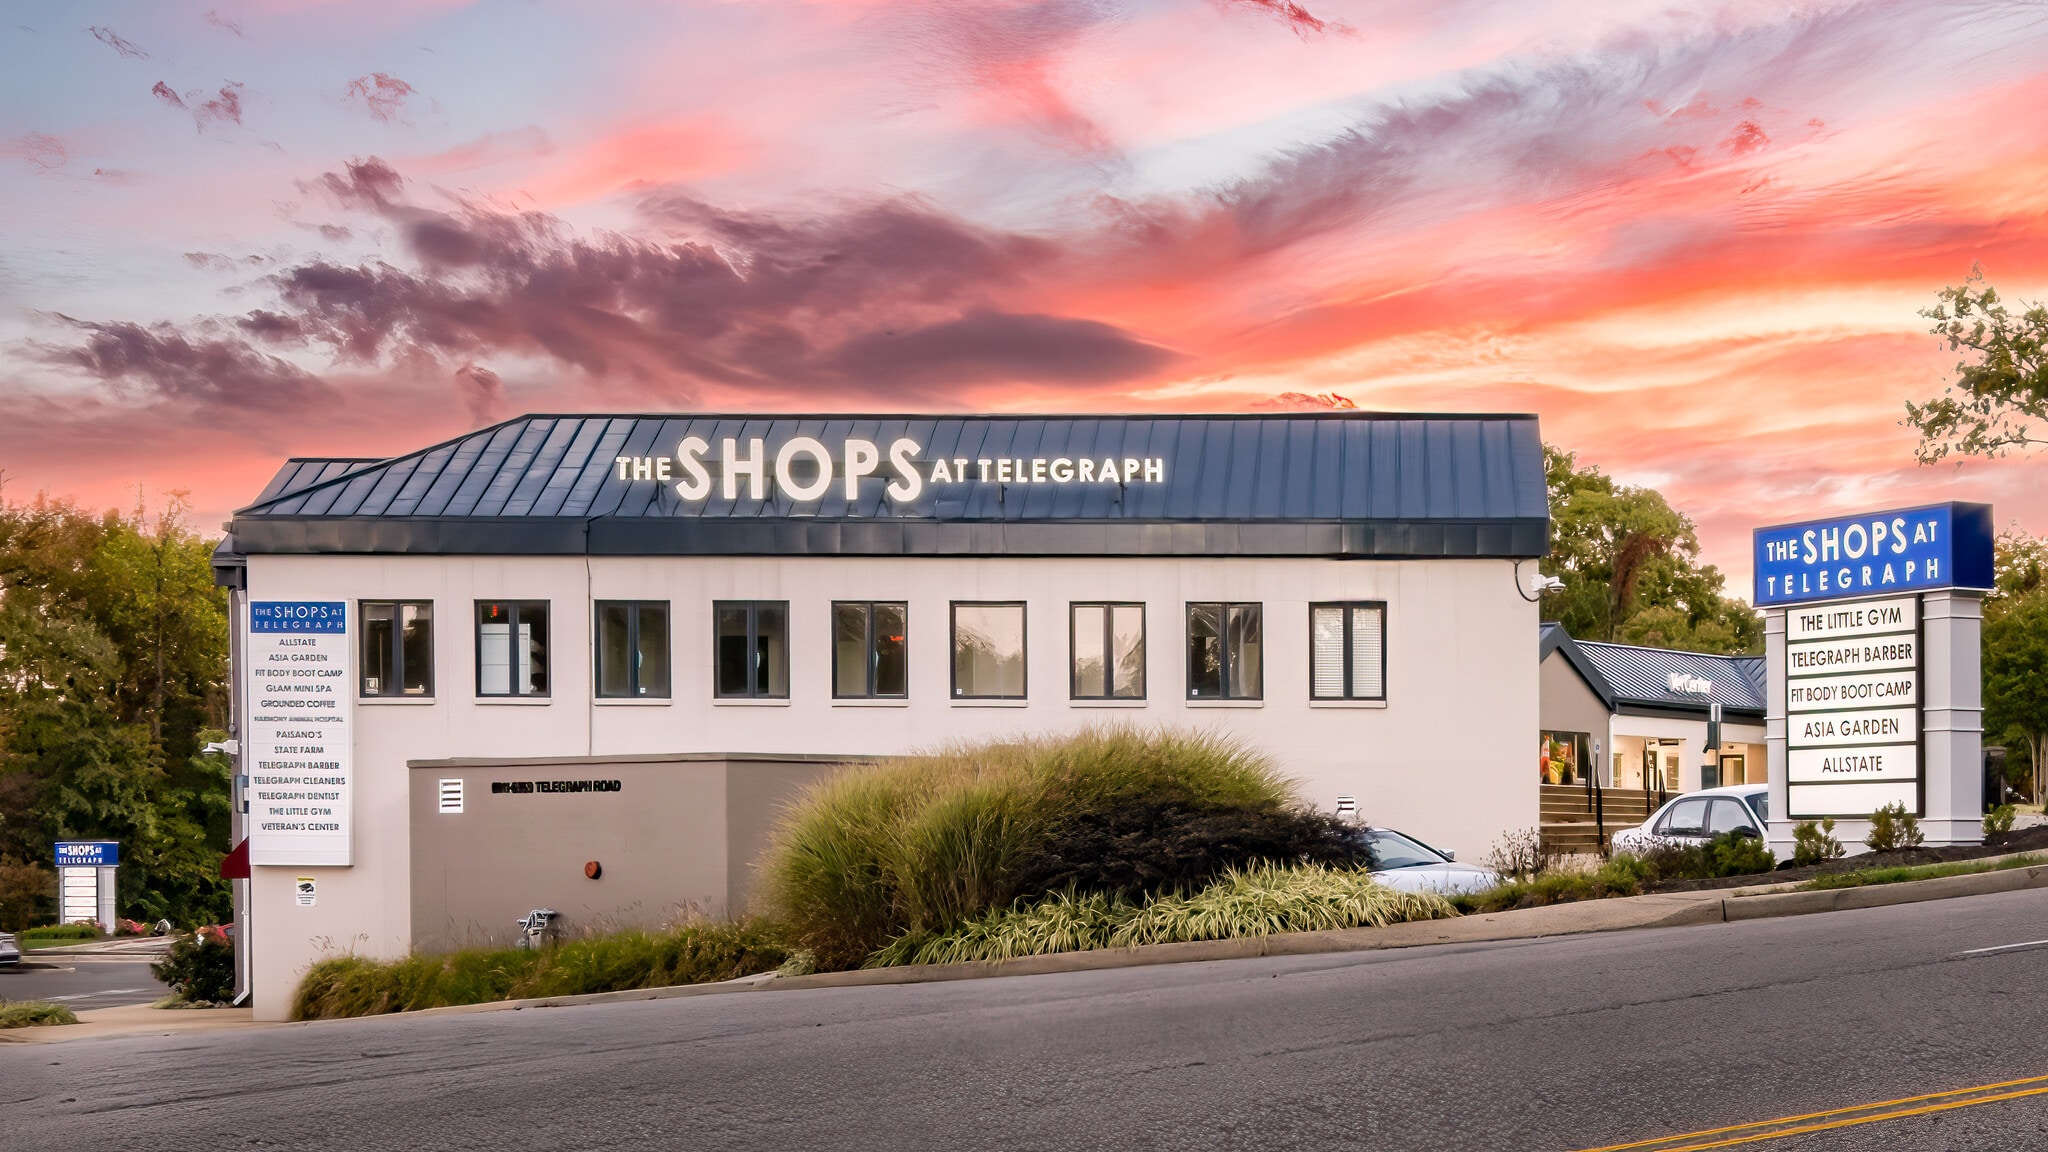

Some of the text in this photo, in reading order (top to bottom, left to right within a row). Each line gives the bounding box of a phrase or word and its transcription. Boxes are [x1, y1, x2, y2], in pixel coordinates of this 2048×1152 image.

[616, 437, 1163, 501] THE SHOPS AT TELEGRAPH
[1766, 518, 1938, 565] THE SHOPS AT
[1767, 558, 1939, 597] TELEGRAPH
[255, 606, 343, 619] THE SHOPS AT
[1800, 607, 1902, 632] THE LITTLE GYM
[255, 621, 344, 629] TELEGRAPH
[279, 639, 317, 647] ALLSTATE
[268, 654, 328, 662] ASIA GARDEN
[1791, 643, 1913, 668] TELEGRAPH BARBER
[255, 669, 266, 677] FIT
[317, 670, 343, 678] CAMP
[265, 684, 333, 693] GLAM MINI SPA
[1791, 680, 1912, 703] FIT BODY BOOT CAMP
[260, 700, 336, 708] GROUNDED COFFEE
[1804, 718, 1899, 739] ASIA GARDEN
[276, 731, 323, 739] PAISANO'S
[274, 746, 325, 754] STATE FARM
[258, 761, 340, 769] TELEGRAPH BARBER
[1822, 755, 1883, 773] ALLSTATE
[253, 777, 346, 785] TELEGRAPH CLEANERS
[535, 780, 593, 793] TELEGRAPH
[593, 780, 621, 792] ROAD
[258, 792, 340, 800] TELEGRAPH DENTIST
[269, 807, 332, 815] THE LITTLE GYM
[261, 823, 340, 831] VETERAN'S CENTER
[67, 845, 95, 856] SHOPS
